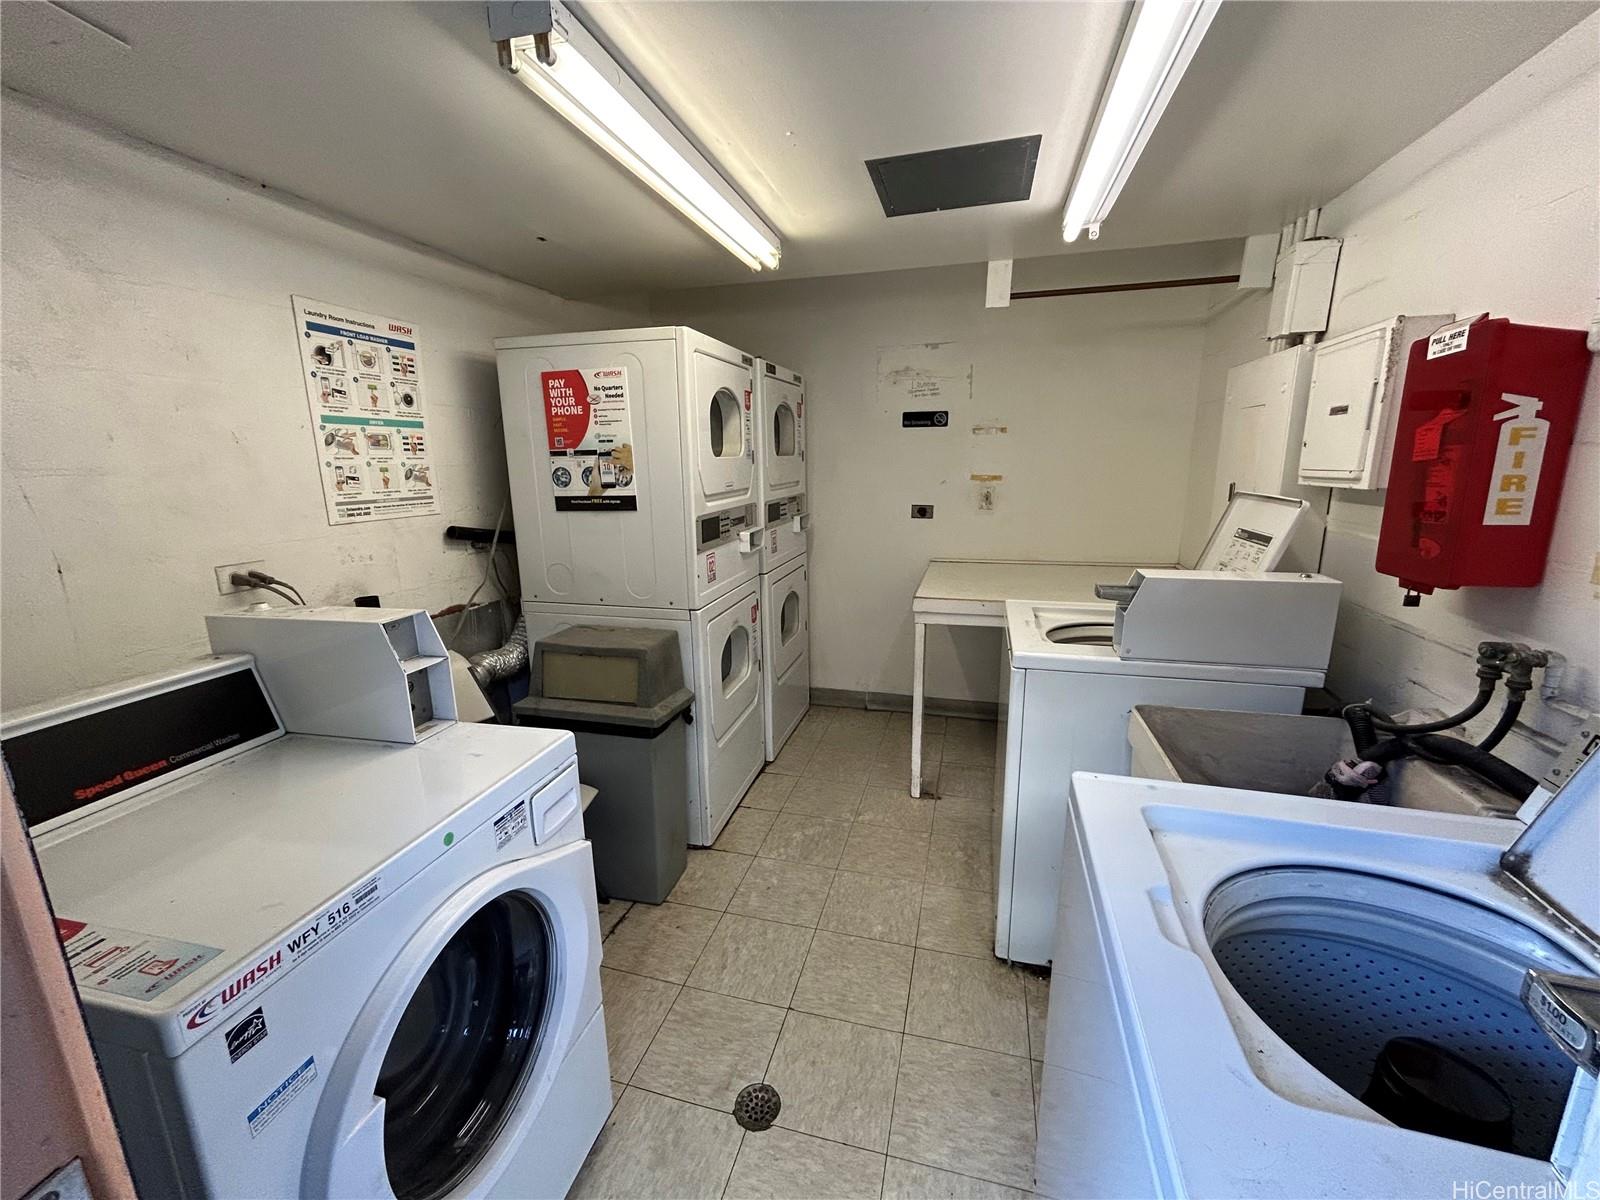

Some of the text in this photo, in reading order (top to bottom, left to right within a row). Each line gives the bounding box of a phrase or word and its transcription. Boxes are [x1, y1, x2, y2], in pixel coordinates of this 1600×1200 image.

[303, 308, 376, 330] Laundry Room Instructions
[339, 329, 389, 344] FRONT LOAD WASHER
[388, 323, 413, 335] WASH
[1432, 329, 1467, 346] PULL HERE
[548, 379, 565, 388] PAY
[549, 388, 573, 397] WITH
[550, 397, 576, 407] YOUR
[551, 406, 584, 416] PHONE
[1494, 426, 1539, 516] FIRE
[73, 731, 241, 800] Speed Queen Commercial Washer
[221, 949, 281, 1005] WASH
[286, 922, 320, 953] WFY
[327, 902, 351, 926] 516
[257, 1063, 307, 1113] NOTICE
